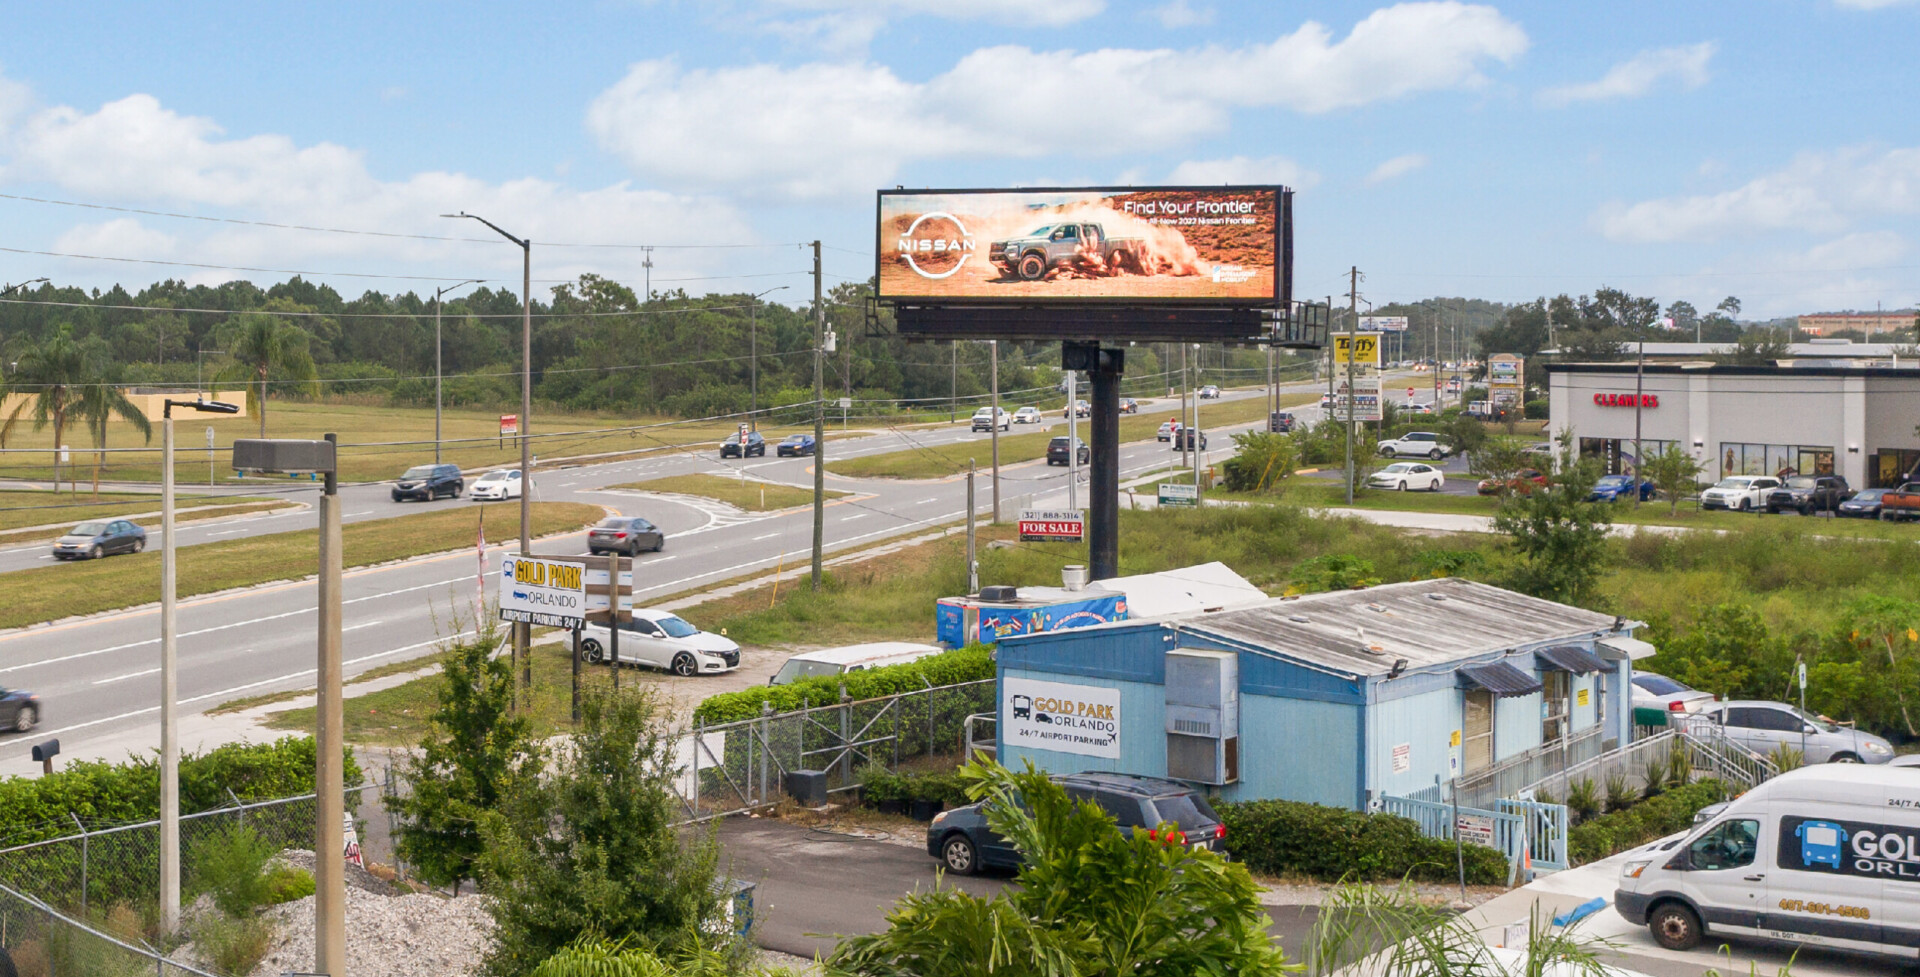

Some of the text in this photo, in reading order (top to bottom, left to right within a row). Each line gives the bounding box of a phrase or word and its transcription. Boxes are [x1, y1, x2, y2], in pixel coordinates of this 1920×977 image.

[1124, 201, 1257, 214] Find Your Frontier.
[1178, 217, 1197, 225] 2022
[1198, 217, 1224, 225] Nissan
[898, 239, 976, 251] NISSAN
[1336, 338, 1375, 351] Tffy
[1022, 522, 1080, 533] FOR SALE
[515, 559, 582, 590] GOLD PARK
[528, 591, 577, 608] ORLANDO
[502, 609, 583, 630] AIRPORT PARKING 24/7
[1035, 697, 1115, 720] GOLD PARK
[1054, 715, 1115, 732] ORLANDO
[1019, 728, 1108, 747] 24/7 AIRPORT PARKING
[1888, 798, 1911, 808] 24/7
